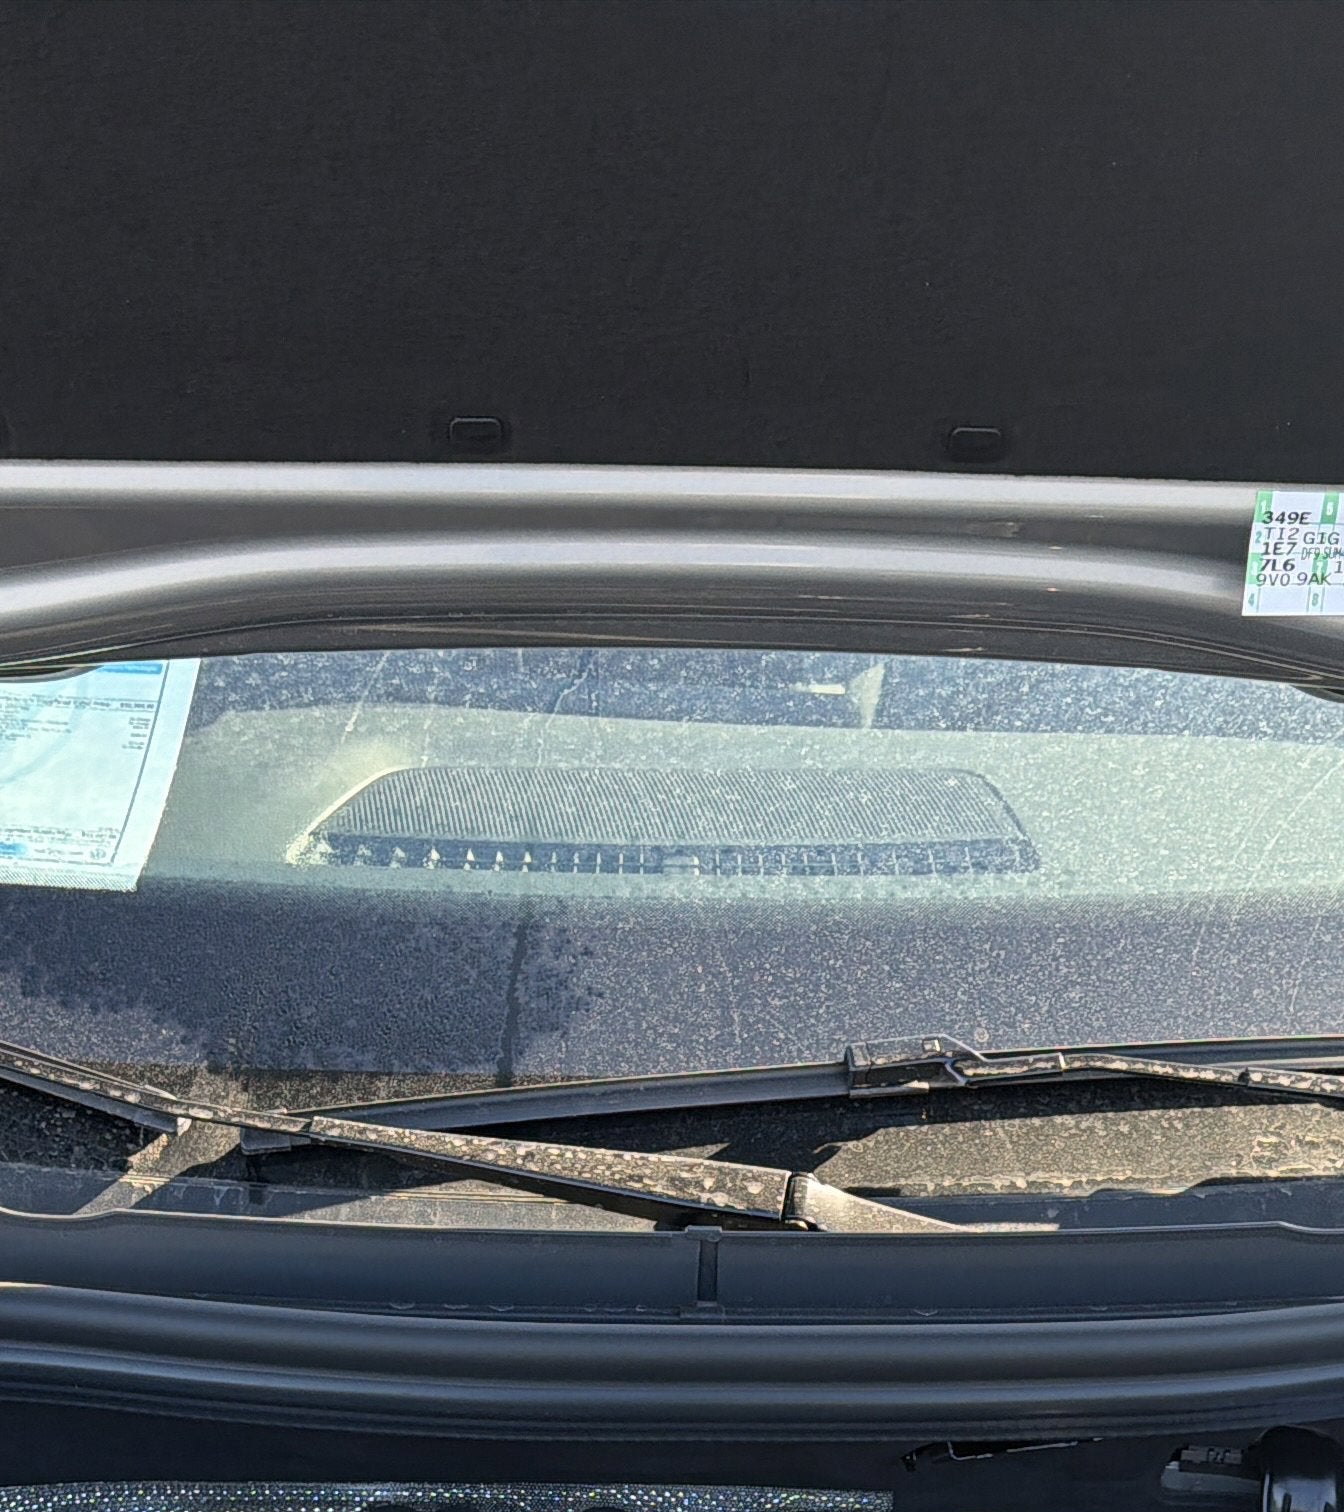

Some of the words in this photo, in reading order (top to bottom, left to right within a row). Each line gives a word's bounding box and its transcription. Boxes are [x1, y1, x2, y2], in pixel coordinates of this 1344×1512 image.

[1262, 510, 1312, 525] 349E
[1254, 530, 1263, 544] 2
[1264, 526, 1300, 541] TI2
[1302, 531, 1341, 546] G1G
[1262, 541, 1299, 555] 1E7
[1259, 558, 1297, 572] 7L6
[1256, 573, 1292, 587] 9V0
[1297, 572, 1332, 586] 9AK
